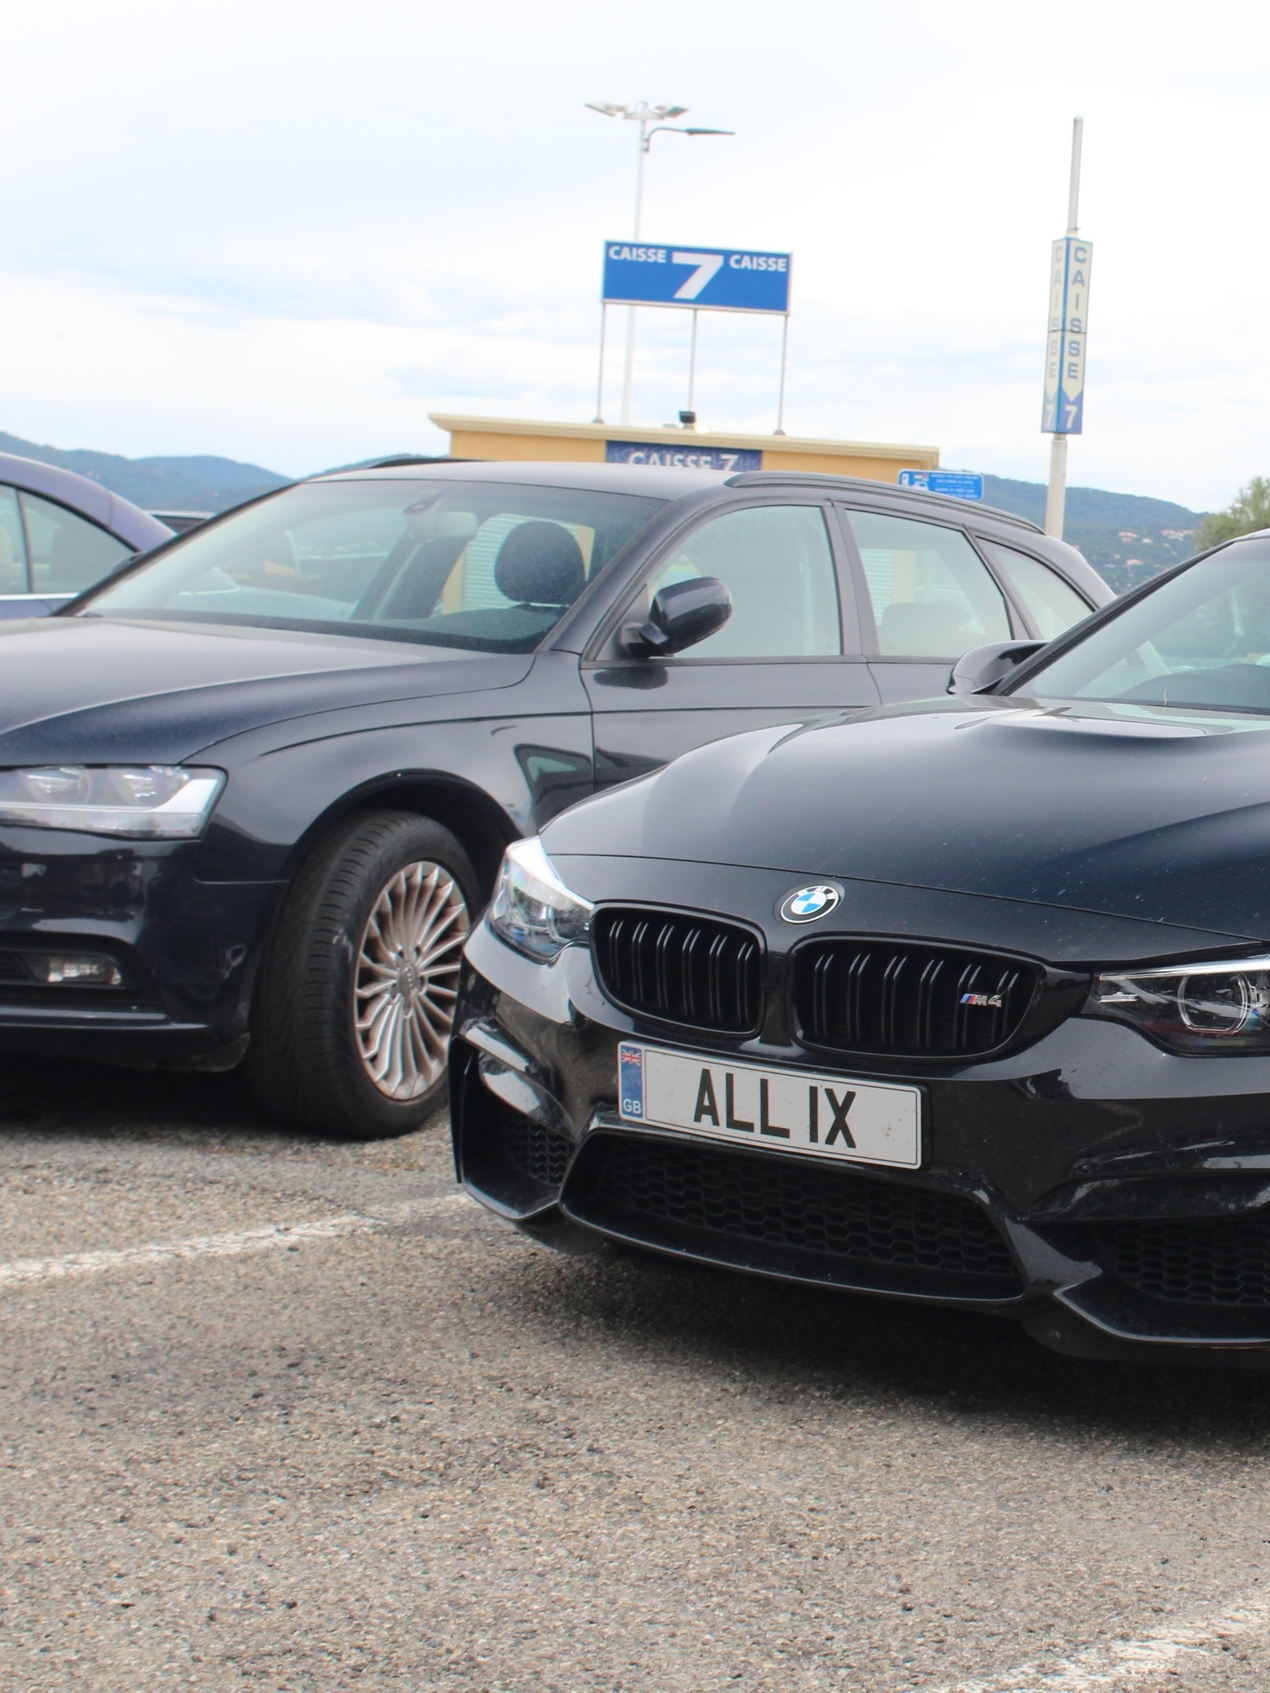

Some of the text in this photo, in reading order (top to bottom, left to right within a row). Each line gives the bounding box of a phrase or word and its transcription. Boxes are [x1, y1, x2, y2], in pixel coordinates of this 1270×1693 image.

[609, 245, 787, 300] CAISSE 7 CAISSE
[1045, 246, 1064, 429] CAISSE 7
[1064, 247, 1087, 430] CAISSE 7
[628, 451, 739, 472] CAISSE 7
[972, 994, 1002, 1008] M4
[622, 1097, 642, 1115] GB
[693, 1068, 791, 1139] ALL
